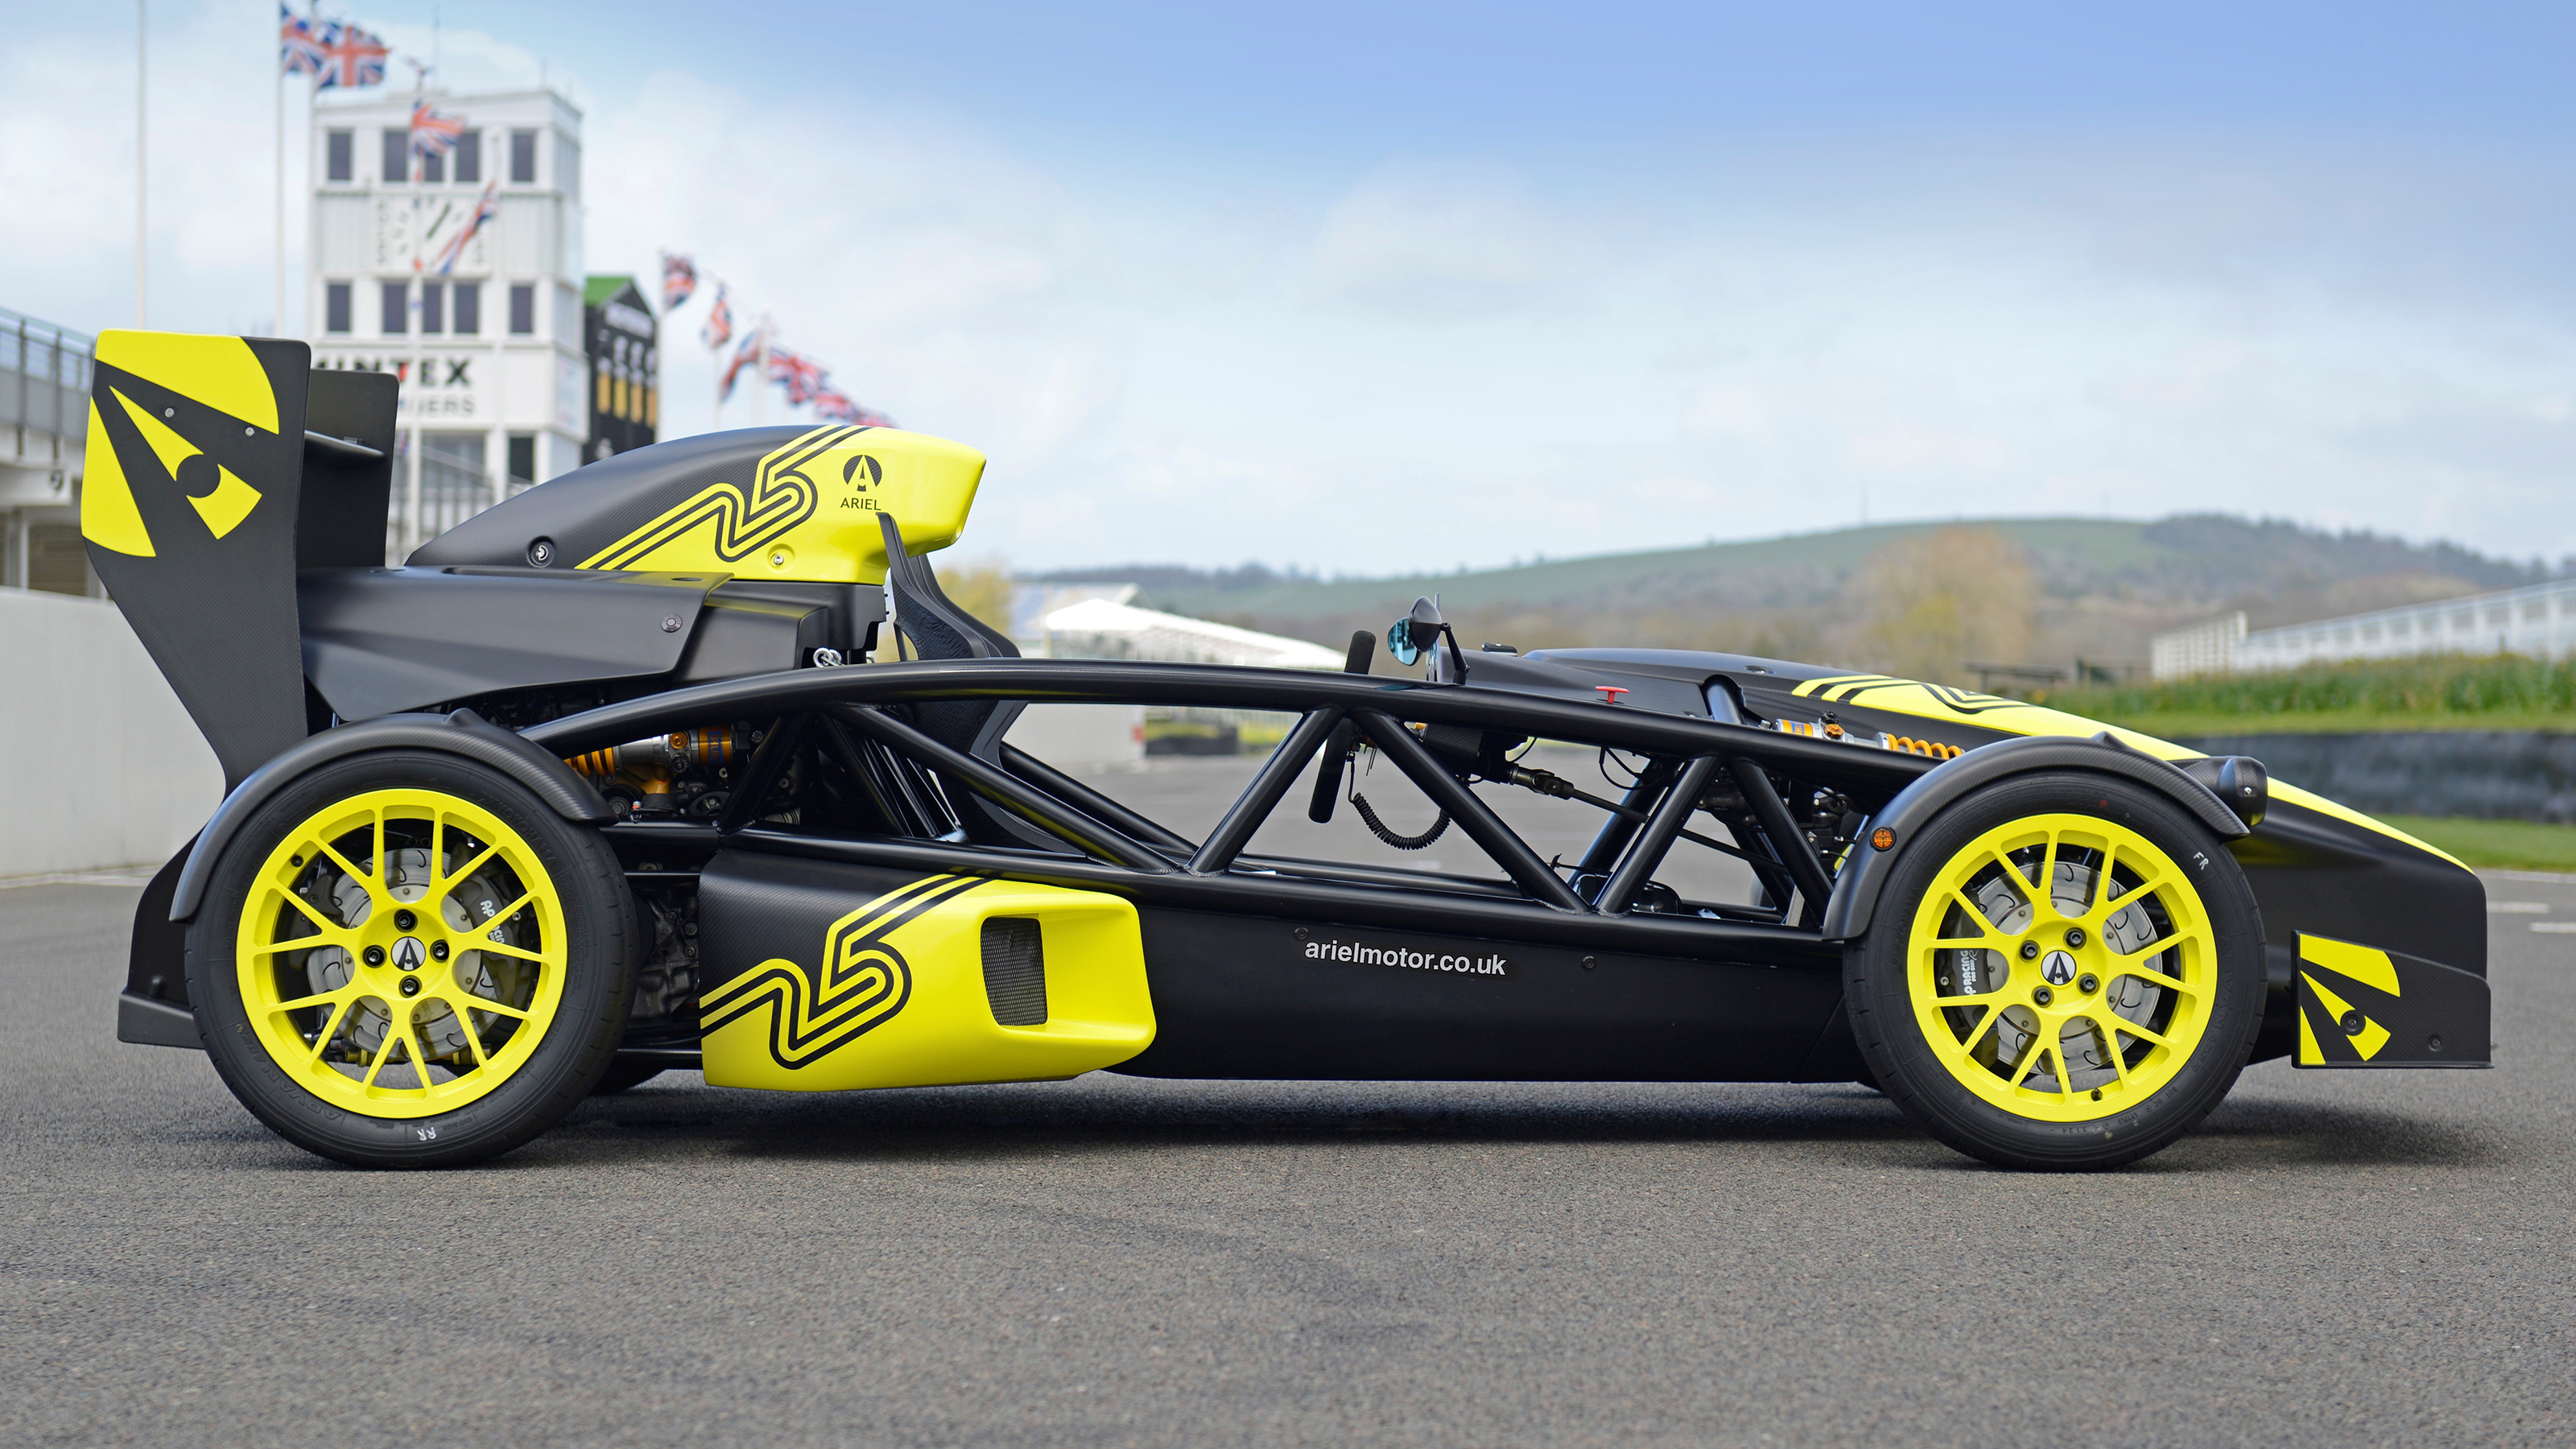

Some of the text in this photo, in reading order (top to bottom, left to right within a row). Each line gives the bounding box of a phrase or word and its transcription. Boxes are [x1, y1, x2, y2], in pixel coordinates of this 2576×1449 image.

[840, 497, 881, 511] ARIEL
[495, 801, 558, 868] YOKOHAMA
[2194, 852, 2211, 870] FR
[1304, 939, 1507, 976] arielmotor.co.uk
[1960, 950, 1972, 986] RACING
[262, 1061, 342, 1125] ADVAN
[416, 1126, 437, 1141] RR
